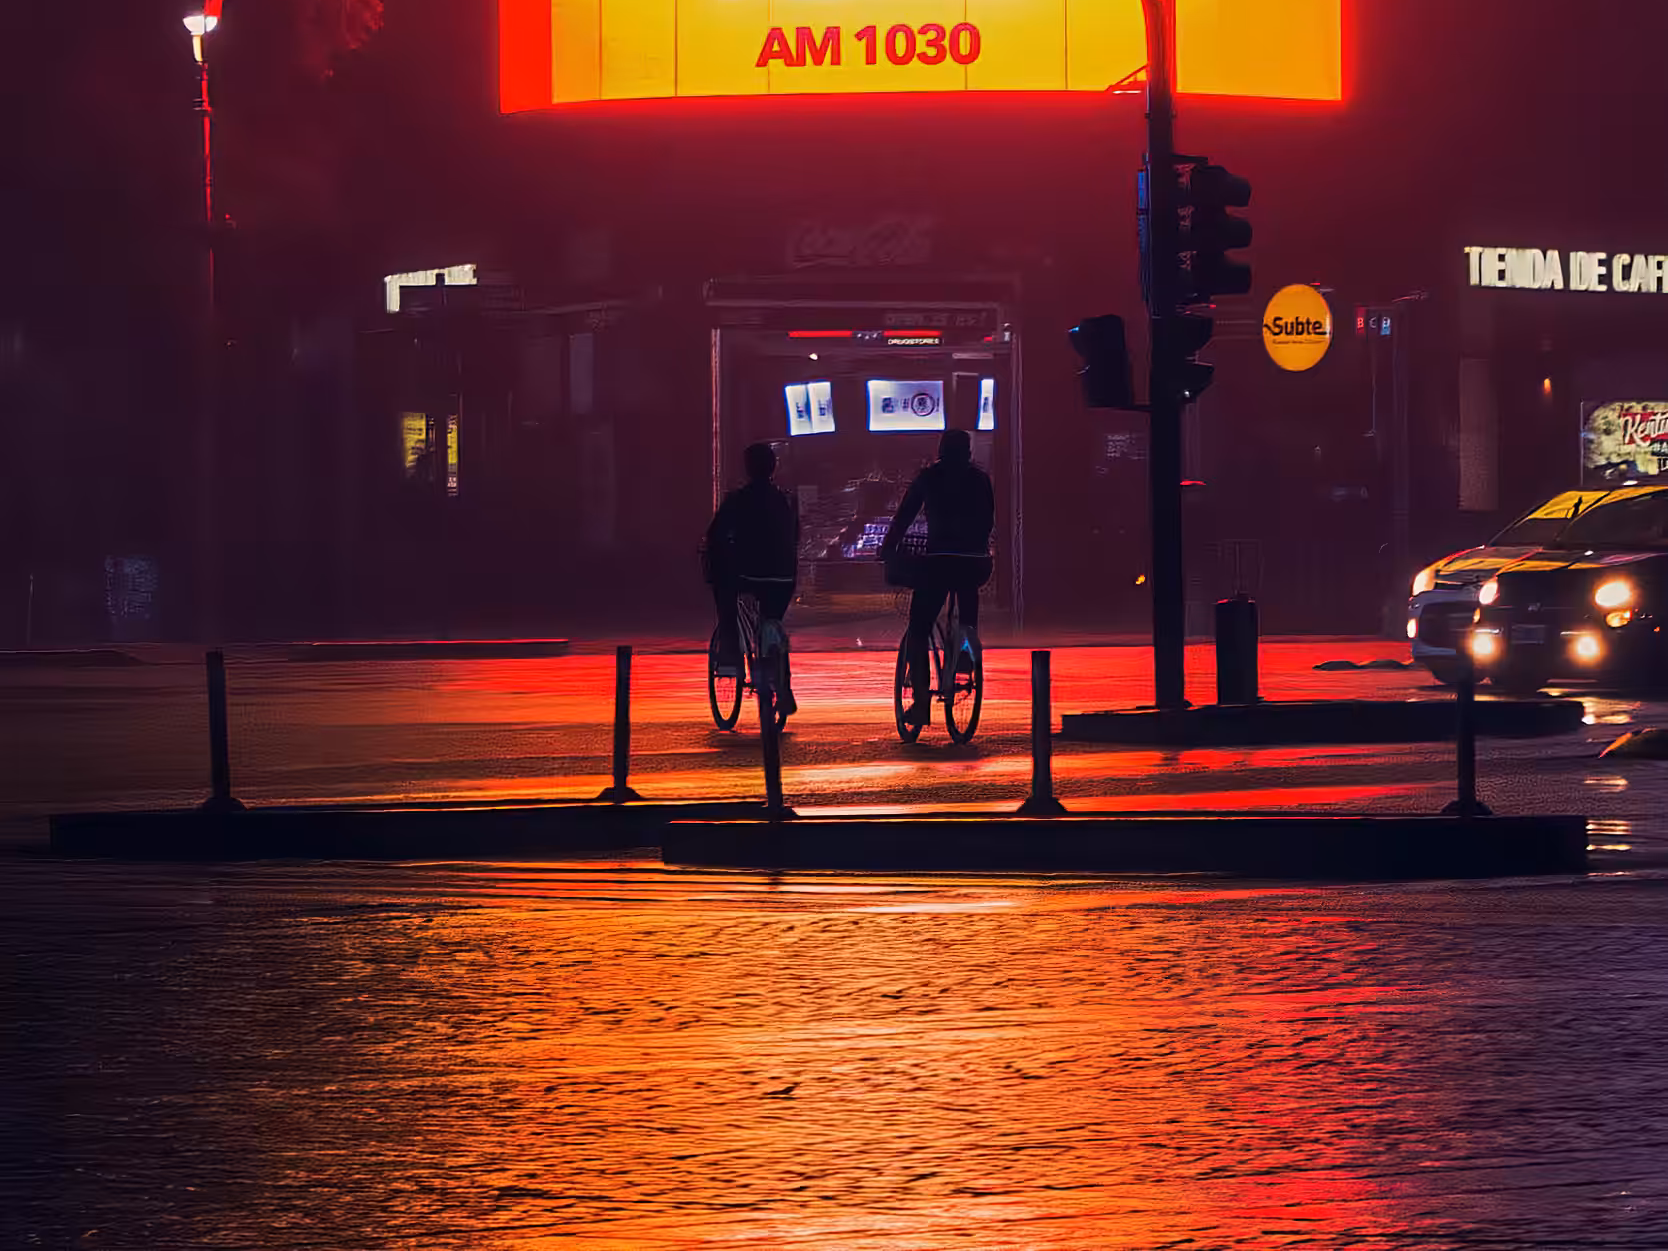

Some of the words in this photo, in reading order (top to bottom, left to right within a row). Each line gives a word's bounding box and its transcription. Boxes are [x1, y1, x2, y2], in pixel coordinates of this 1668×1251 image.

[755, 25, 842, 68] AM
[854, 22, 983, 66] 1030
[1464, 246, 1564, 290] TIENDA
[1569, 251, 1608, 292] DE
[1612, 252, 1668, 294] CAF
[1271, 316, 1326, 336] Subte
